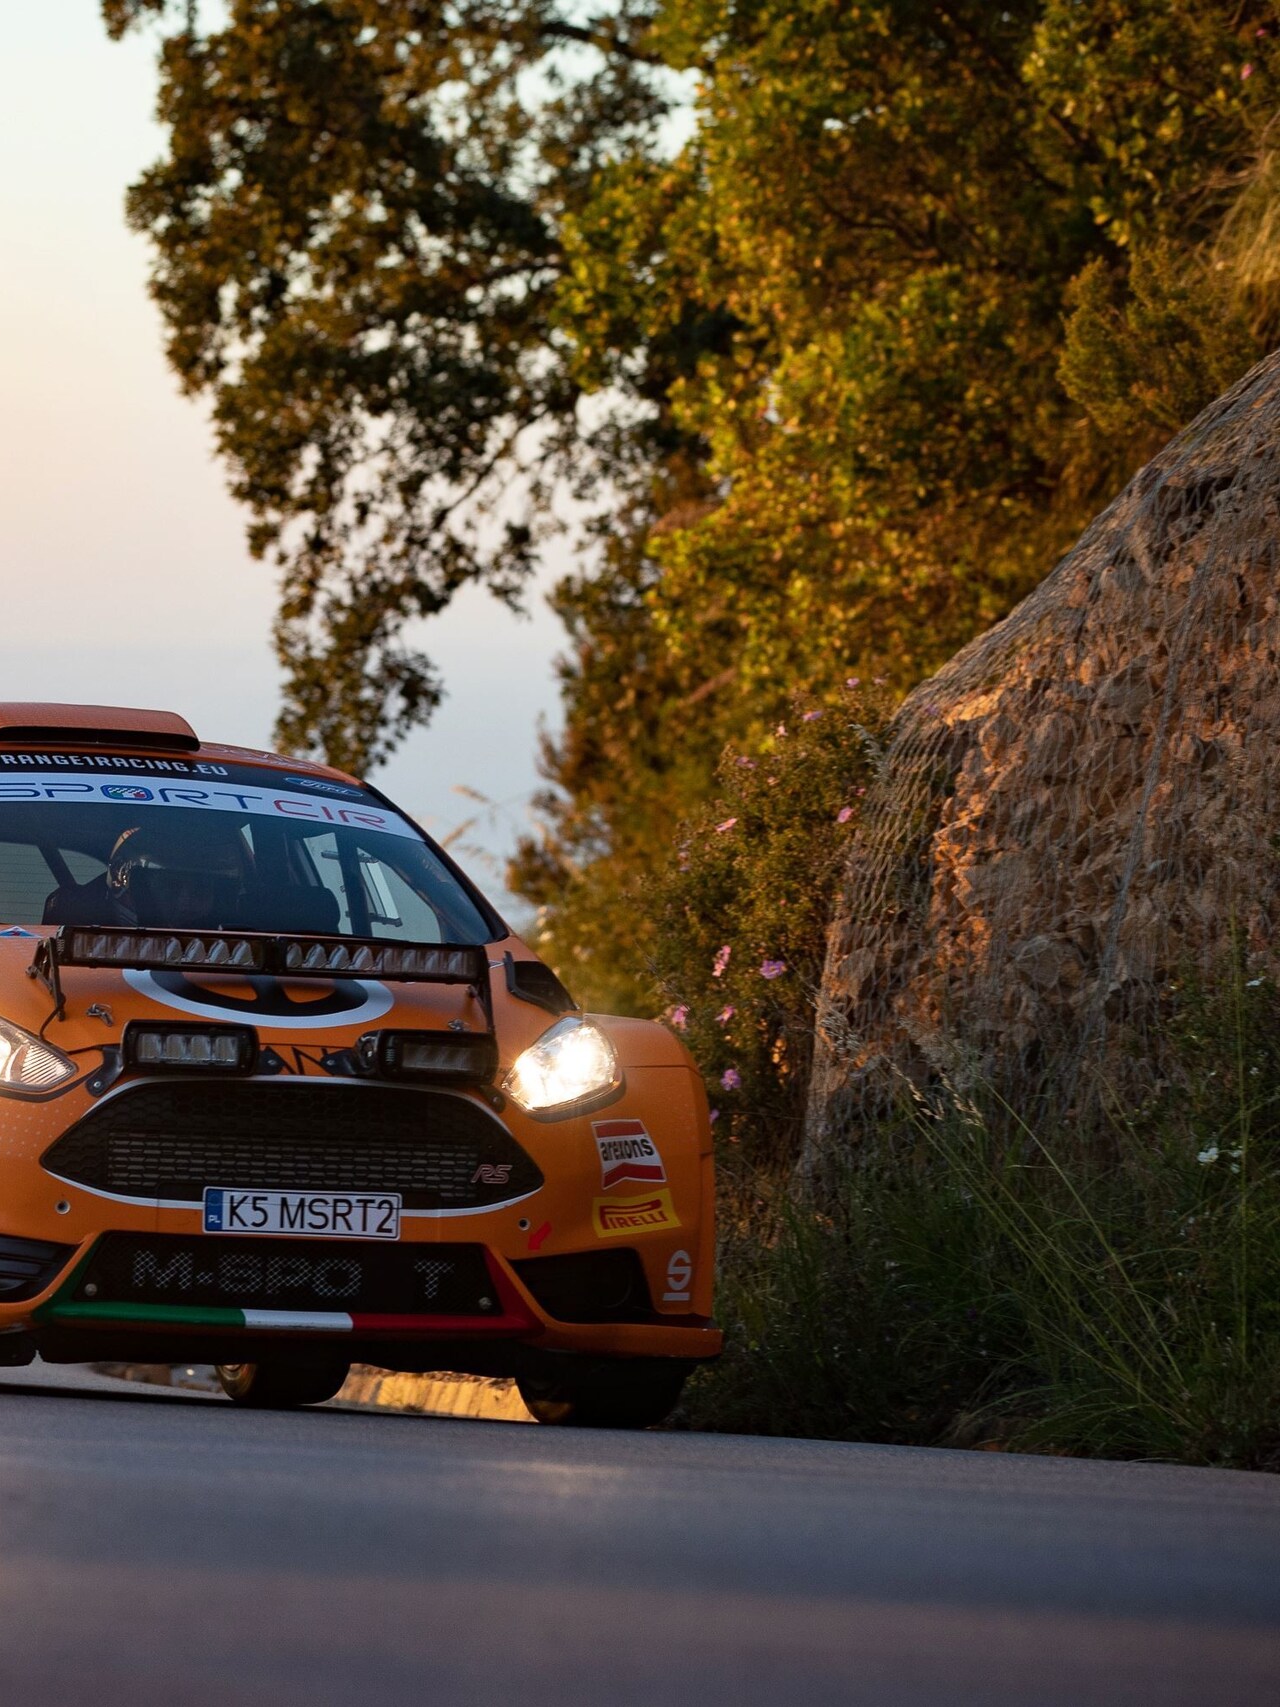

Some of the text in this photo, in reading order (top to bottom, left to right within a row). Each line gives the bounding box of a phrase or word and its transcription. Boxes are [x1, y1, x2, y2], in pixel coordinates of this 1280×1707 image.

[300, 779, 349, 794] Ford
[273, 799, 388, 830] CIR
[600, 1138, 655, 1162] arexons
[471, 1164, 512, 1184] RS
[207, 1214, 221, 1223] PL
[228, 1195, 394, 1234] K5 MSRT2
[599, 1199, 669, 1230] PIRELLI
[132, 1249, 456, 1299] M-SPOT
